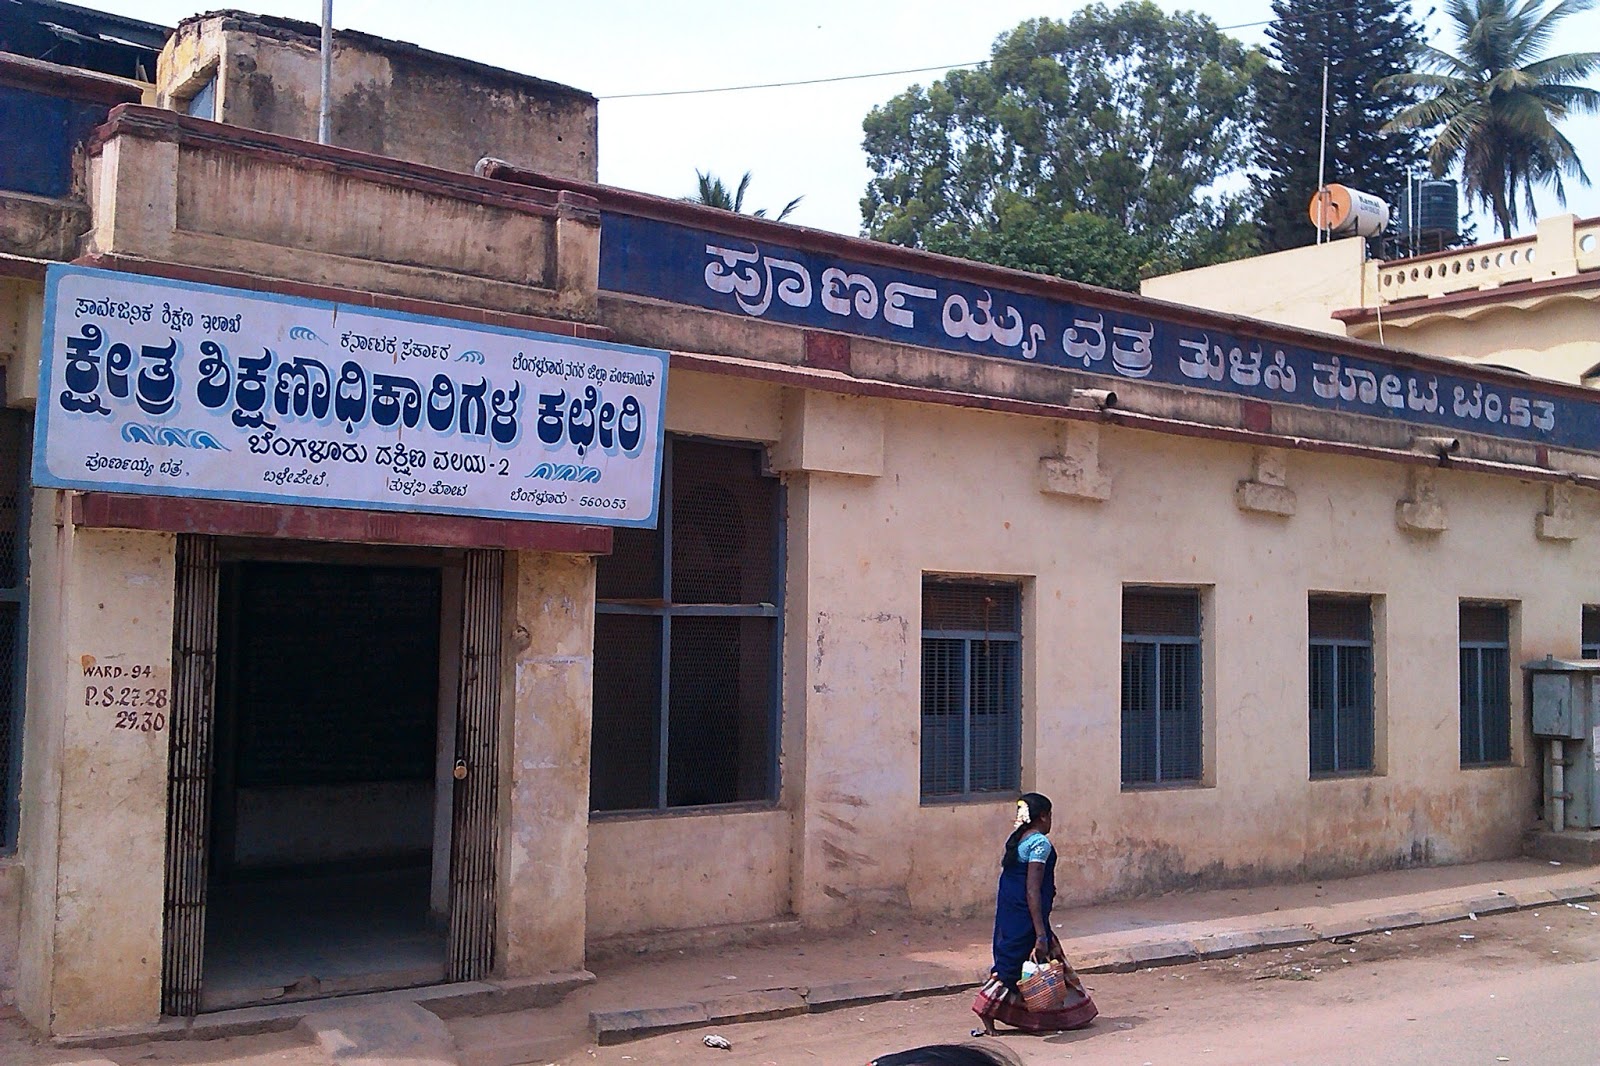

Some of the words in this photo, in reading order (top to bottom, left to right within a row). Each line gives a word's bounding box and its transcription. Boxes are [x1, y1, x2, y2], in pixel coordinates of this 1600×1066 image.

[75, 297, 154, 326] ಸಾರ್ವಜನಿಕ
[162, 302, 194, 333] ಶಿಕ್ಷಣ
[201, 313, 242, 334] ಇಲಾಖೆ
[340, 331, 397, 354] ಕರ್ನಾಟಕ
[400, 338, 451, 361] ಸರ್ಕಾರ
[1178, 333, 1298, 393] ತುಳಸಿ
[59, 323, 177, 415] ಕ್ಷೇತ್ರ
[197, 340, 520, 444] ಶಿಕ್ಷಣಾಧಿಕಾರಿಗಳ
[85, 452, 155, 477] ಪೂರ್ಣಯ್ಯ
[248, 431, 368, 464] ಬೆಂಗಳೂರು
[375, 442, 426, 476] ದಕ್ಷಿಣ
[389, 478, 427, 497] ತುಳಸಿ
[428, 480, 468, 497] ತೋಟ
[510, 487, 568, 506] ಬೆಂಗಳೂರು
[579, 496, 627, 510] 560053
[114, 710, 166, 732] 29.30
